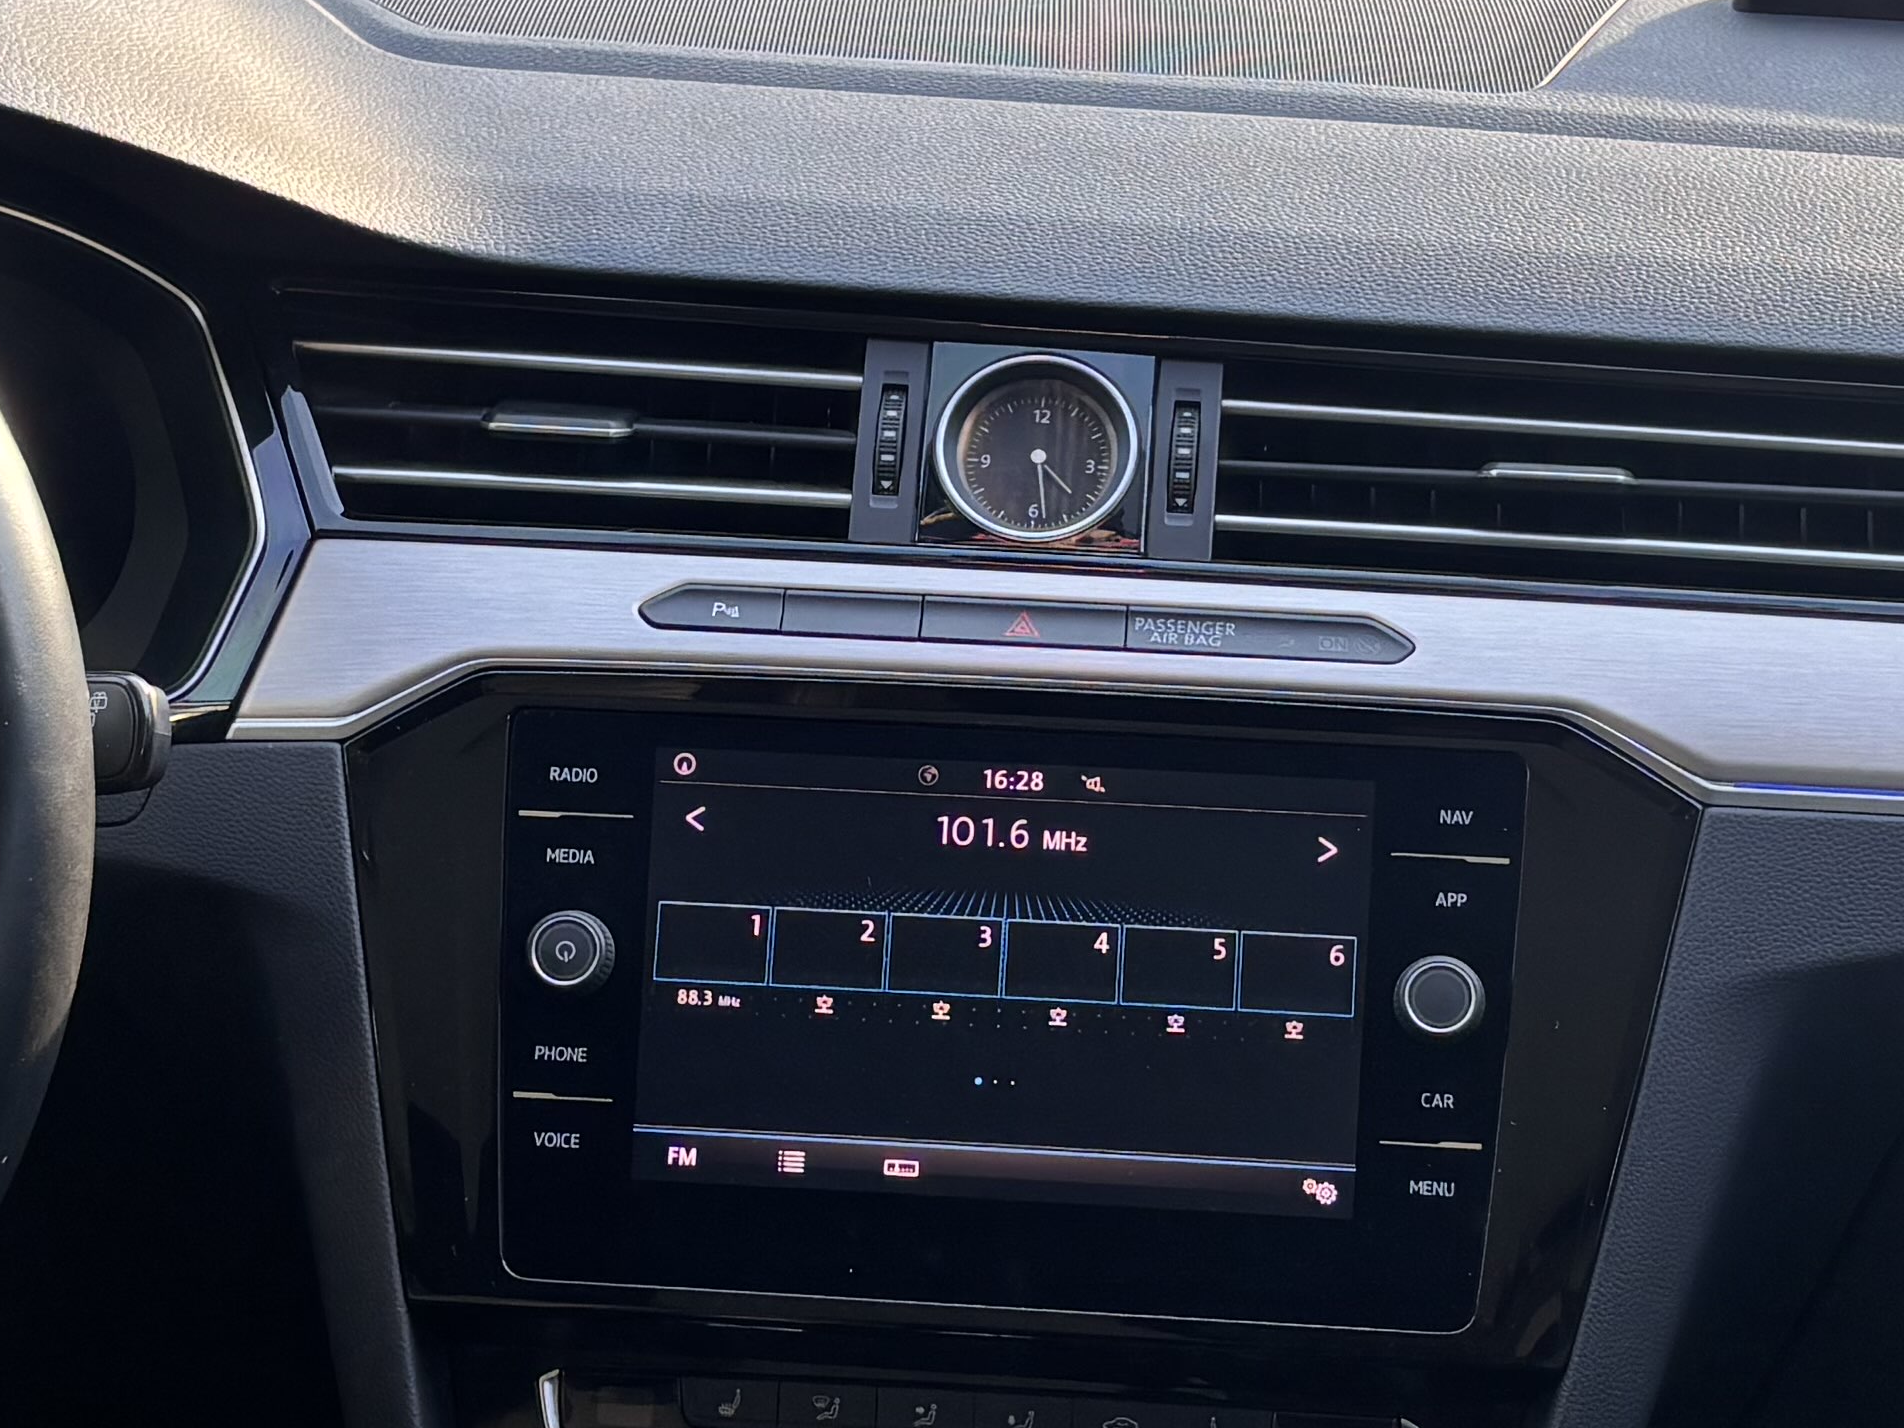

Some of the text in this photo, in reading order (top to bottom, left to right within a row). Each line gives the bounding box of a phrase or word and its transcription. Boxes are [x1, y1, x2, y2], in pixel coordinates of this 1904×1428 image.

[1033, 409, 1051, 424] 12
[980, 454, 992, 469] 9
[1085, 459, 1096, 474] 3
[1028, 504, 1039, 518] 6
[1134, 617, 1236, 637] PASSENGER
[1149, 632, 1223, 647] AIR BAG
[549, 765, 599, 784] RADIO
[983, 769, 1045, 792] 16:28
[1439, 809, 1474, 825] NAV
[937, 815, 1088, 853] 101.6 MHz
[546, 847, 595, 865] MEDIA
[1435, 891, 1468, 908] APP
[750, 913, 762, 937] 1
[859, 919, 876, 943] 2
[977, 925, 993, 949] 3
[1093, 931, 1110, 955] 4
[1212, 937, 1228, 961] 5
[1328, 944, 1346, 967] 6
[676, 988, 742, 1009] 88.3 MHz
[534, 1045, 588, 1063] PHONE
[1420, 1092, 1455, 1109] CAR
[533, 1131, 581, 1149] VOICE
[667, 1146, 698, 1167] FM
[1409, 1179, 1455, 1198] MENU
